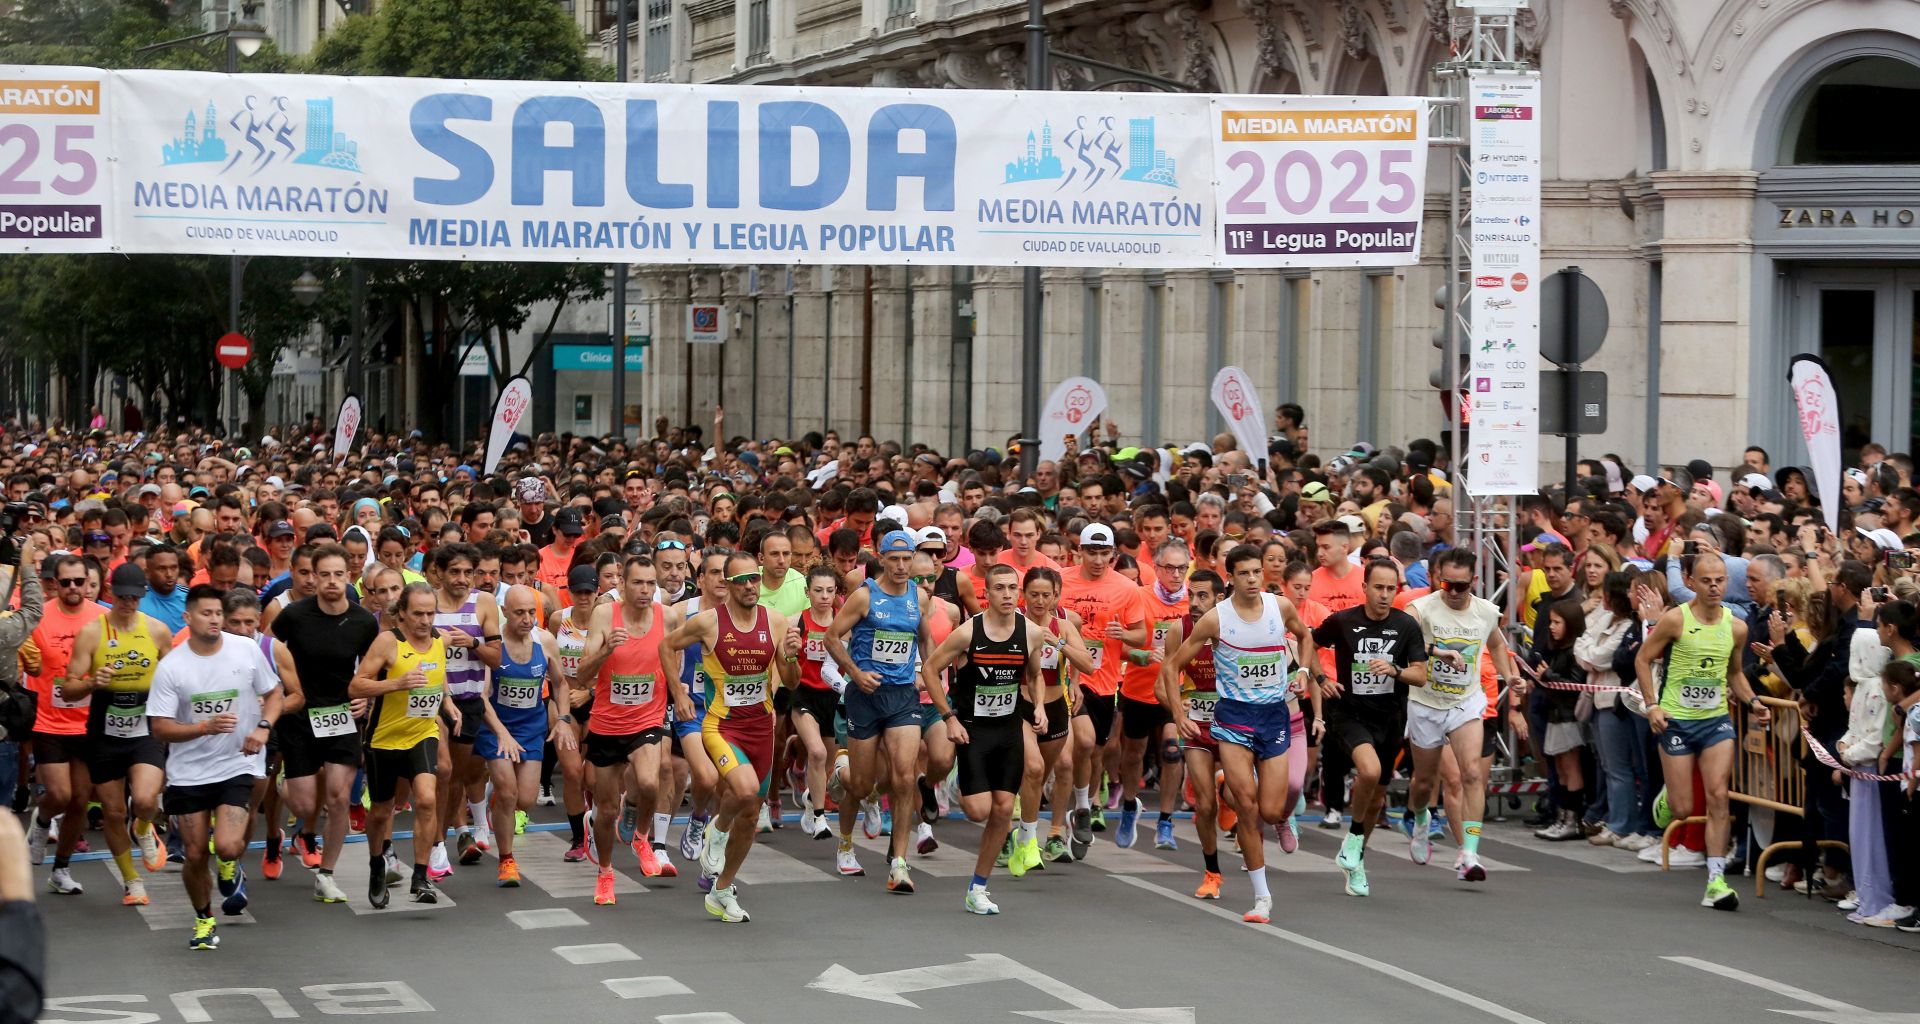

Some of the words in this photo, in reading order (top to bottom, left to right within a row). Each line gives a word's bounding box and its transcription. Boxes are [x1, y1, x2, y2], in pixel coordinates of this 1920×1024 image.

[0, 85, 94, 106] RATÓN
[1227, 118, 1298, 134] MEDIA
[1304, 114, 1412, 134] MARATÓN
[409, 92, 957, 212] SALIDA
[1225, 149, 1416, 215] 2025
[1489, 174, 1505, 182] NTT
[134, 180, 228, 210] MEDIA
[237, 181, 388, 214] MARATÓN
[978, 199, 1064, 224] MEDIA
[1072, 196, 1201, 227] MARATÓN
[1779, 208, 1856, 225] ZARA
[1, 211, 96, 237] Popular
[186, 225, 233, 240] CIUDAD
[237, 227, 252, 240] DE
[256, 228, 338, 242] VALLADOLID
[409, 218, 512, 247] MEDIA
[521, 216, 673, 250] MARATÓN
[682, 222, 703, 250] Y
[714, 223, 807, 252] LEGUA
[820, 225, 955, 252] POPULAR
[1263, 231, 1326, 252] Legua
[1335, 228, 1414, 251] Popular
[1475, 234, 1531, 242] SONRISALUD
[1022, 240, 1066, 253] CIUDAD
[1070, 241, 1084, 253] DE
[1087, 241, 1161, 254] VALLADOLID
[580, 351, 612, 363] Clínica
[446, 647, 463, 659] 06
[875, 639, 909, 654] 3728
[1240, 663, 1276, 678] 3481
[1433, 660, 1468, 676] 334
[1354, 672, 1389, 685] 3517
[500, 685, 535, 700] 3550
[612, 682, 649, 696] 3512
[726, 681, 763, 696] 3495
[1682, 685, 1716, 699] 3396
[194, 698, 232, 714] 3567
[410, 694, 440, 708] 3699
[976, 693, 1013, 707] 3718
[1190, 698, 1215, 712] 342
[107, 714, 141, 728] 3347
[313, 712, 348, 729] 3580
